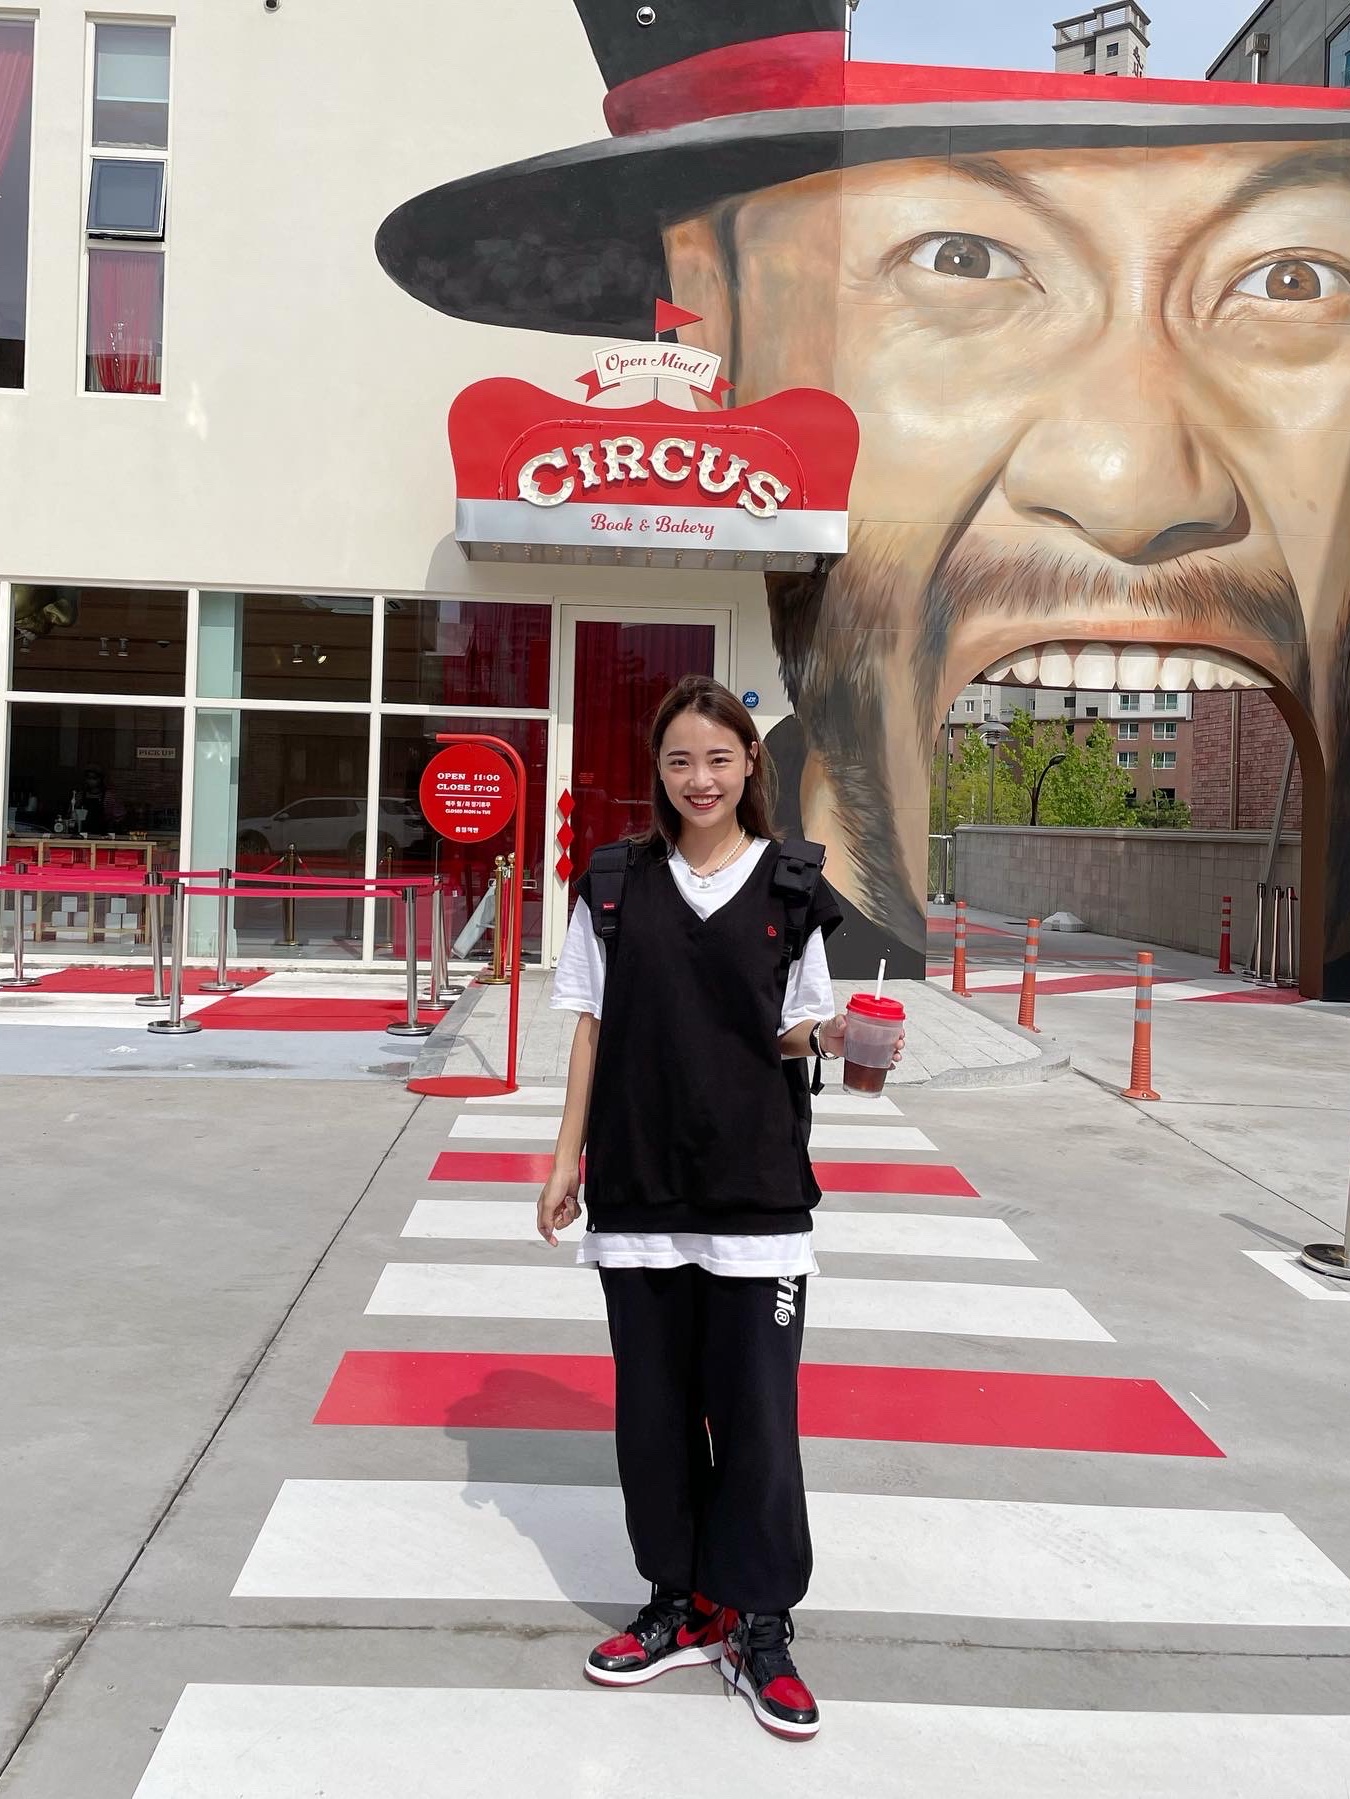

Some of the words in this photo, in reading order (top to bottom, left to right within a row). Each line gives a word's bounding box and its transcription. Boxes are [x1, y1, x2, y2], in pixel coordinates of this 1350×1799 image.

[605, 353, 647, 374] Open
[651, 352, 710, 377] Mind!
[517, 435, 792, 519] CIRCUS
[590, 513, 633, 532] Book
[639, 518, 650, 532] &
[655, 515, 715, 541] Bakery
[436, 783, 471, 791] CLOSE
[437, 772, 466, 780] OPEN
